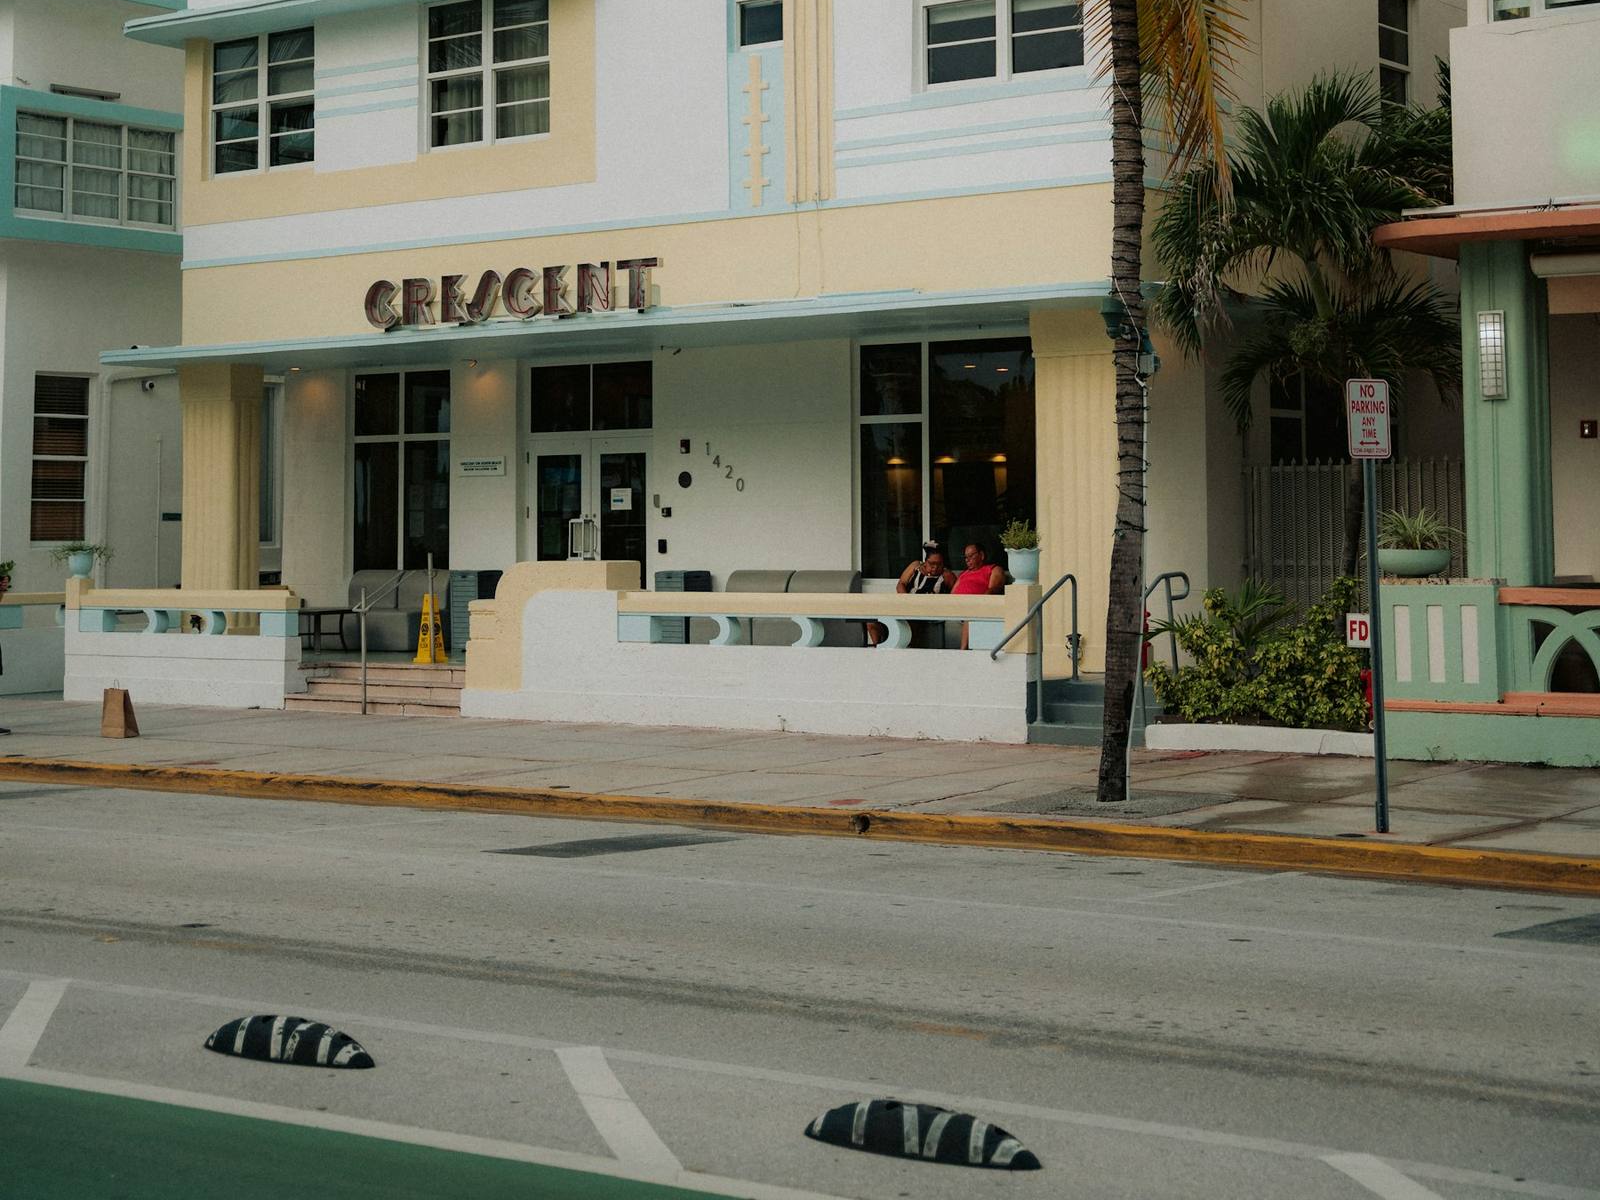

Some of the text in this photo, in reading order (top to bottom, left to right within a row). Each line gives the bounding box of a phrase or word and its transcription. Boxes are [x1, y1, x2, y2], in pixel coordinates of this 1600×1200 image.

[364, 257, 662, 330] CRESCENT
[1360, 384, 1375, 398] NO
[1351, 401, 1385, 413] PARKING
[1362, 417, 1375, 426] ANY
[1362, 429, 1376, 438] TIME
[705, 441, 744, 492] 1420
[1349, 620, 1369, 641] FD
